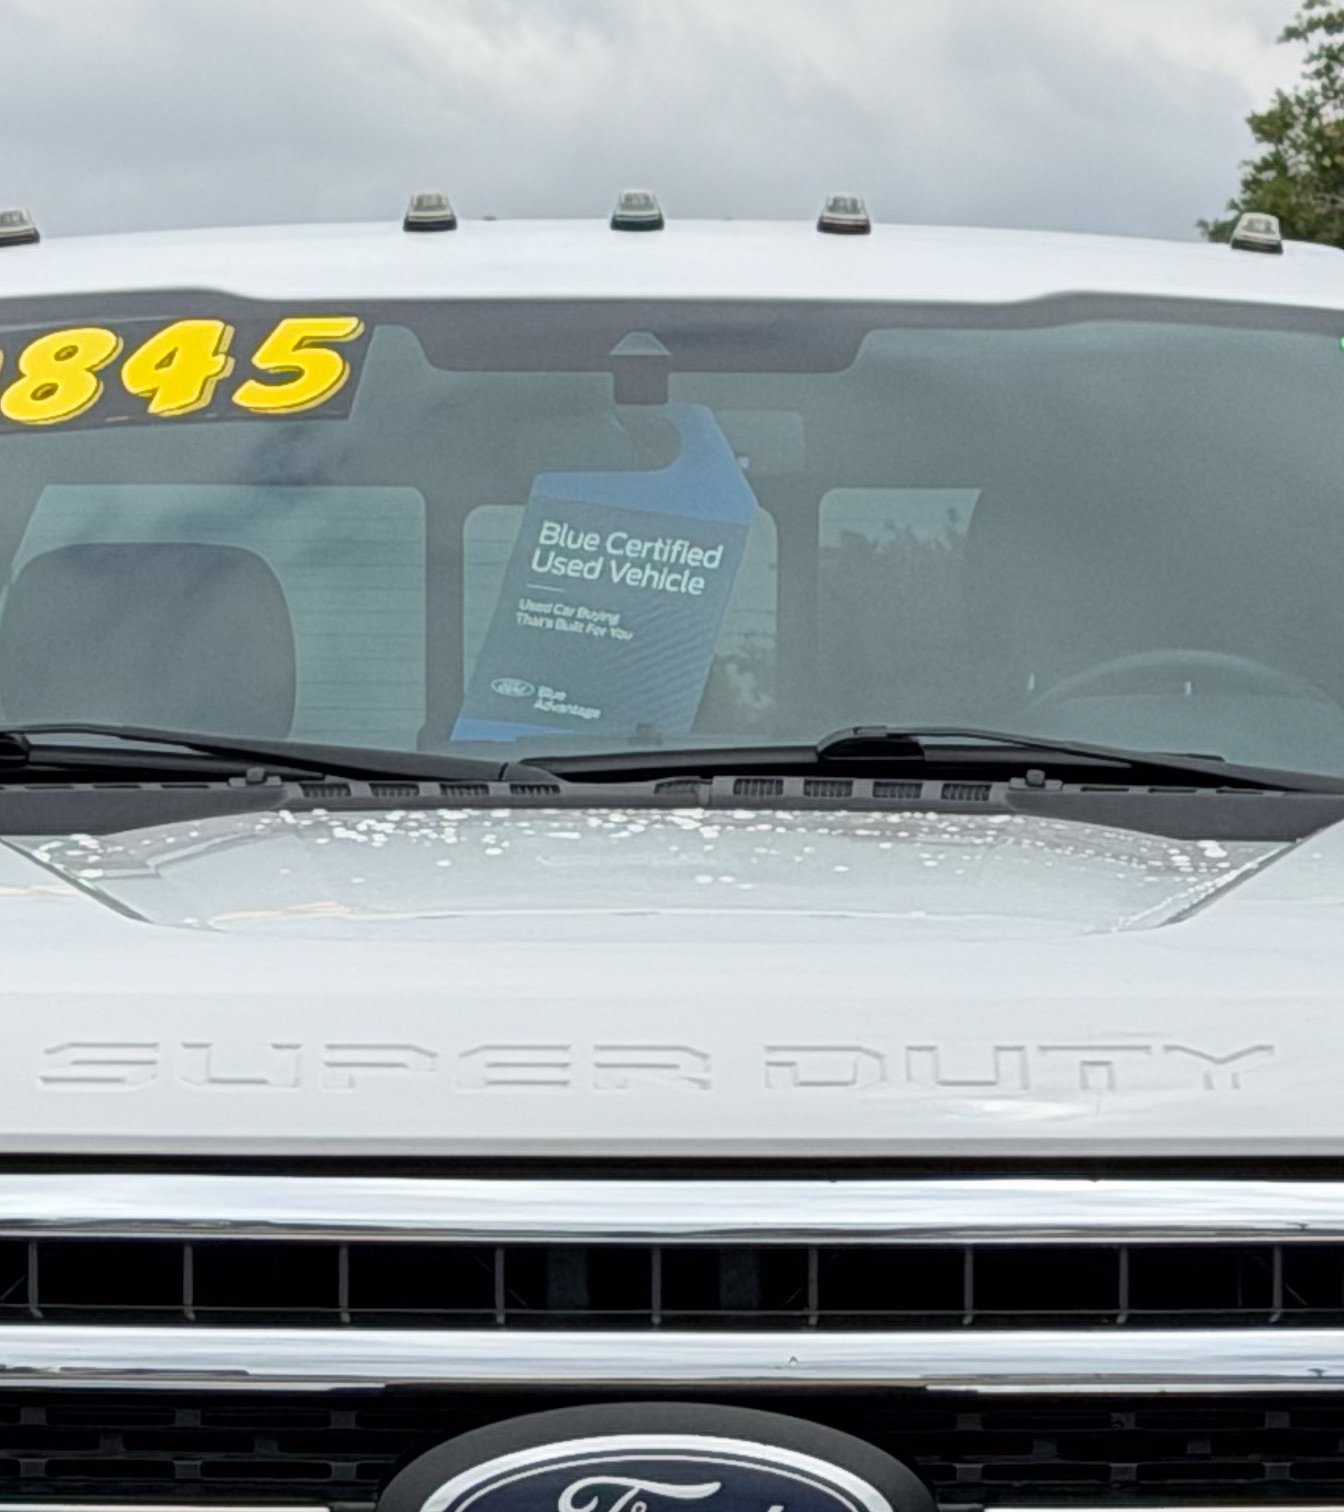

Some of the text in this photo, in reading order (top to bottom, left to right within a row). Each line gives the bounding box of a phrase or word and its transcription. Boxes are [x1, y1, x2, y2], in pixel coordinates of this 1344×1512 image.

[539, 520, 724, 569] Blue Certified
[531, 548, 706, 596] Used Vehicle
[38, 1042, 1275, 1091] SUPER DUTY
